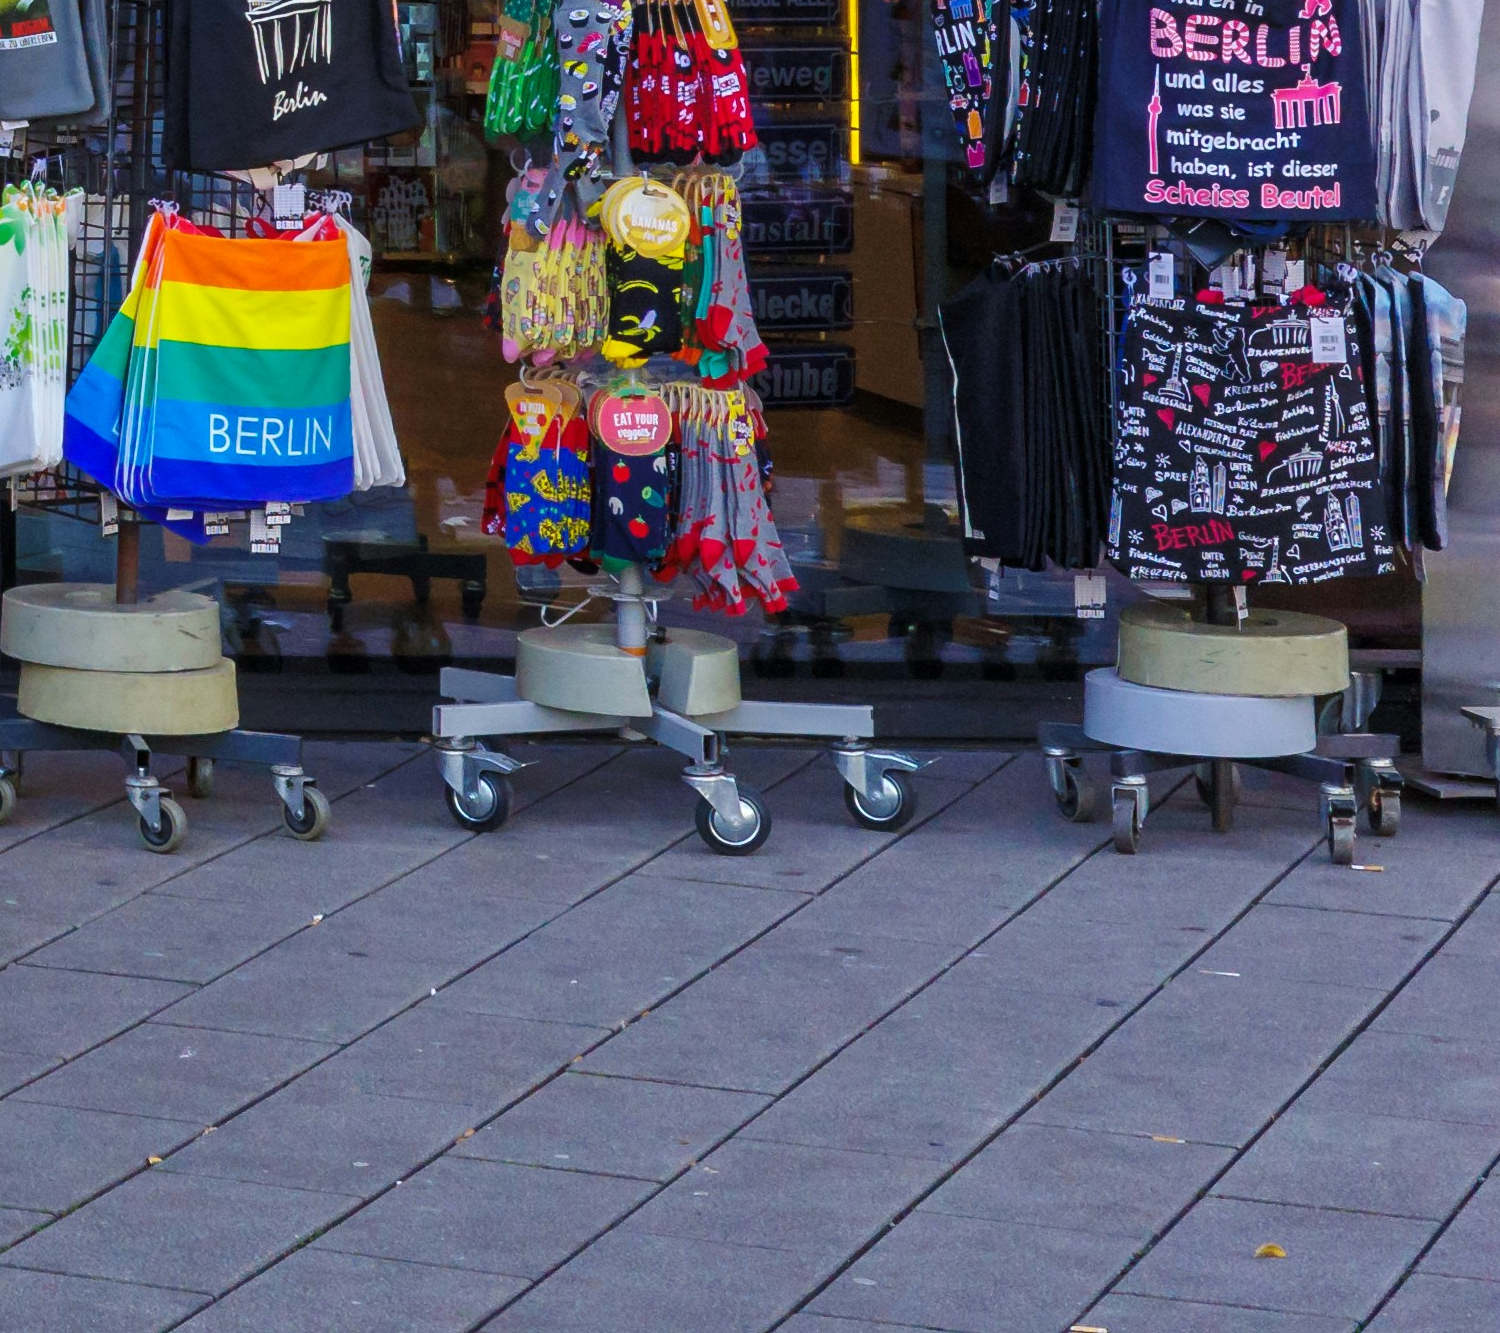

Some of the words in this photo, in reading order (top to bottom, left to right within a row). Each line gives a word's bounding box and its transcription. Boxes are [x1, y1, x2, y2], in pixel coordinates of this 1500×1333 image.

[9, 38, 17, 48] ZU
[1149, 7, 1342, 68] BERLIN
[1164, 70, 1207, 90] und
[1211, 74, 1265, 95] alles
[272, 81, 328, 122] Berlin
[1177, 103, 1214, 120] was
[1221, 104, 1246, 121] sie
[1166, 129, 1301, 152] mitgebracht
[1171, 157, 1237, 180] haben,
[1248, 159, 1275, 178] ist
[1281, 158, 1338, 178] dieser
[1144, 179, 1250, 210] Scheiss
[1260, 181, 1341, 210] Beutel
[276, 219, 304, 230] BERLIN
[631, 214, 677, 231] BANANAS
[1185, 342, 1214, 355] SPREE
[1224, 382, 1277, 397] KREUZBERG
[614, 412, 632, 426] EAT
[635, 413, 659, 425] YOUR
[208, 413, 333, 456] BERLIN
[617, 425, 657, 440] veggies!
[1175, 421, 1245, 450] ALEXANDERPLATZ
[1229, 462, 1253, 473] UNTER
[1155, 471, 1188, 482] SPREE
[1228, 481, 1257, 490] LINDEN
[1277, 504, 1292, 514] Dom
[1151, 519, 1235, 551] BERLIN
[251, 544, 279, 553] BERLIN
[1201, 552, 1225, 561] UNTER
[1130, 565, 1188, 580] KREUZBERG
[1200, 569, 1230, 579] LINDEN
